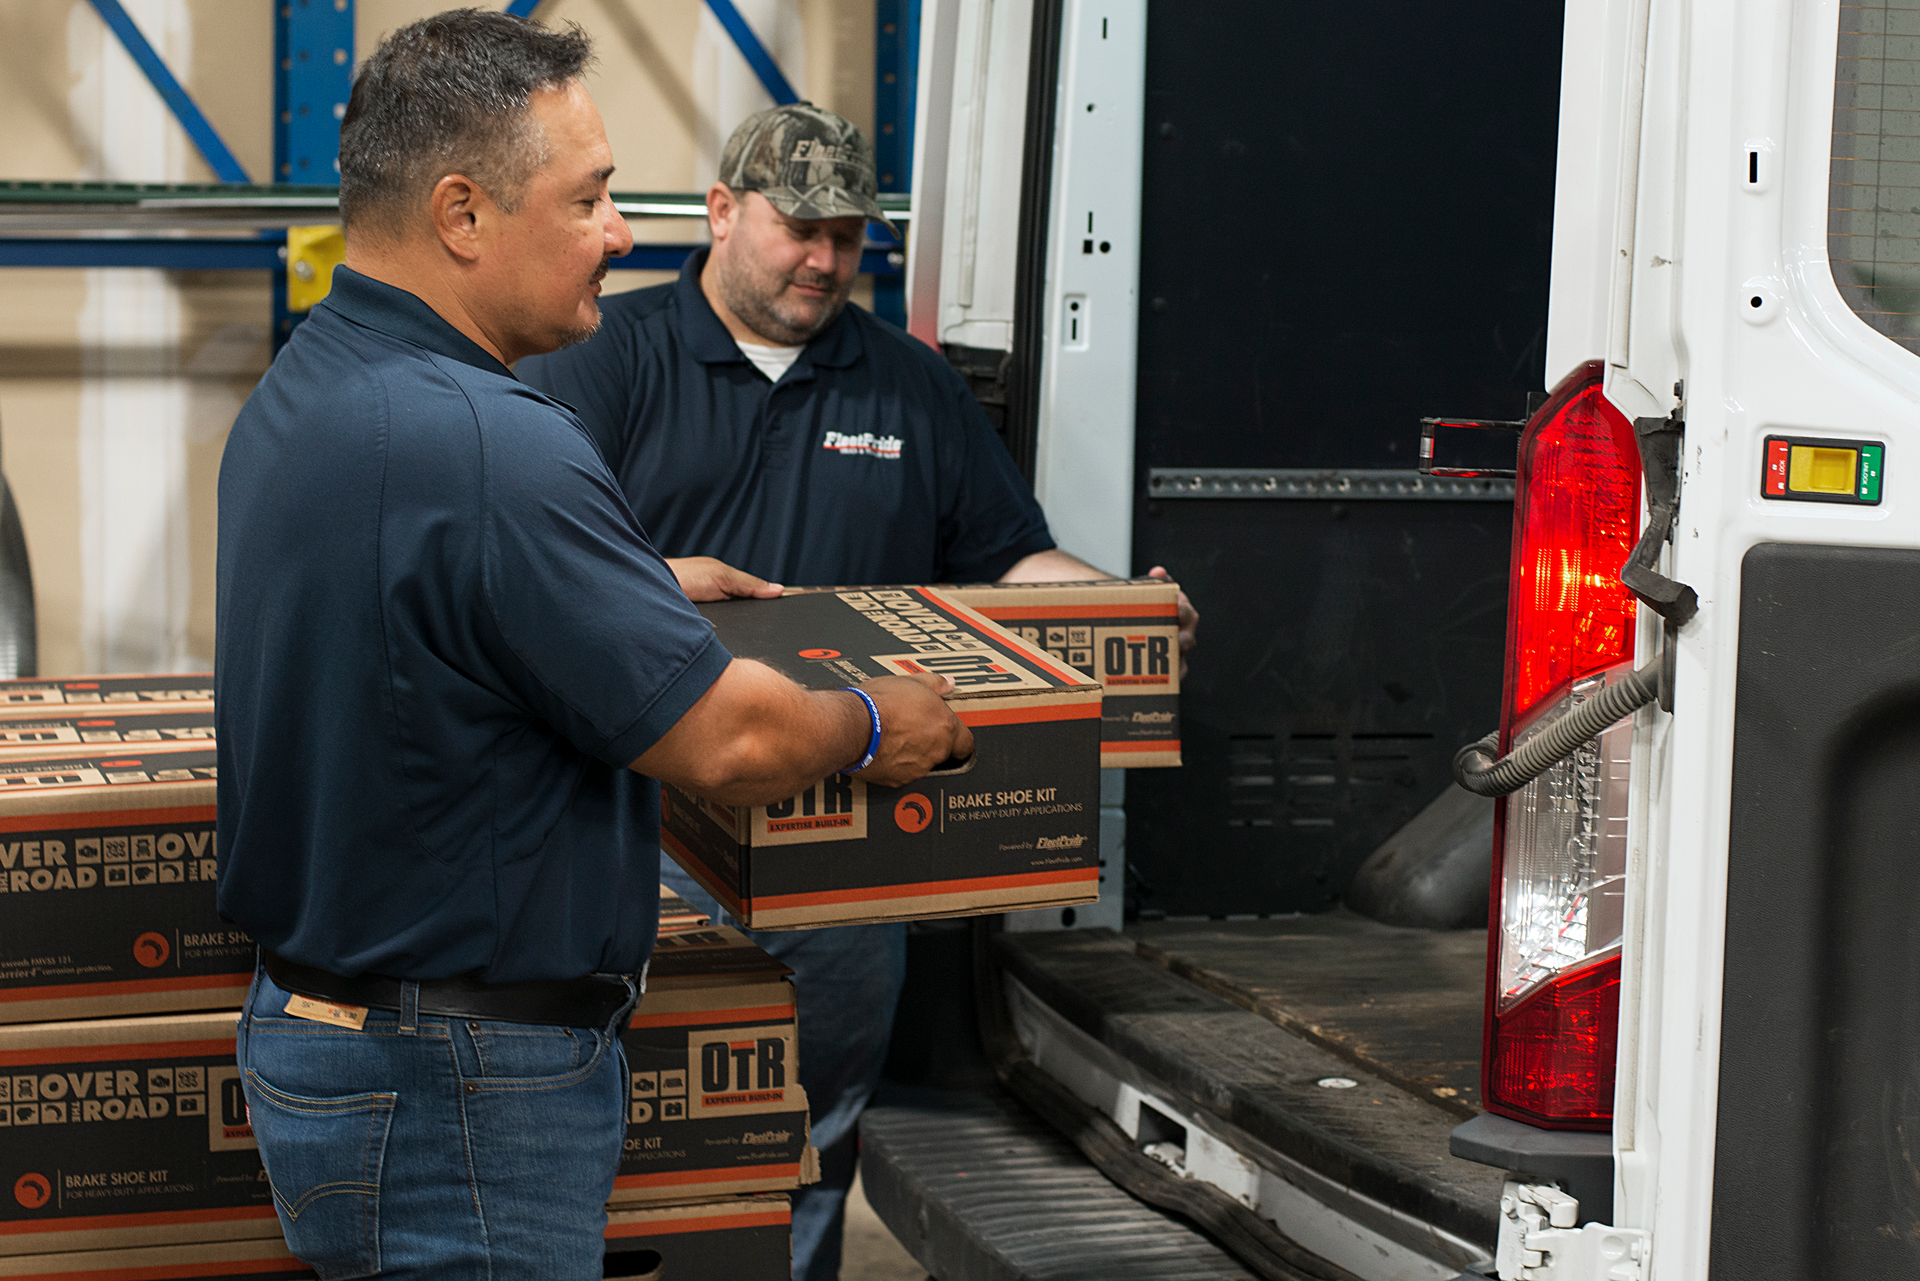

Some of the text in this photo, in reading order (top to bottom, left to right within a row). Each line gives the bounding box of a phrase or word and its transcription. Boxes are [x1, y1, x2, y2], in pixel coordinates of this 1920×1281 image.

[823, 431, 902, 451] FleetPride
[867, 613, 931, 643] ROAD
[884, 600, 958, 633] OVER
[1104, 635, 1170, 676] OTR
[948, 787, 1058, 809] BRAKE SHOE KIT
[949, 803, 1083, 822] FOR HEAVY-DUTY APPLICATIONS
[769, 818, 850, 832] EXPERTISE BUILT-IN
[157, 831, 217, 860] OV
[10, 865, 98, 893] ROAD
[184, 932, 224, 948] BRAKE
[702, 1037, 785, 1093] OTR
[39, 1070, 140, 1100] OVER
[71, 1096, 169, 1123] THE ROAD
[705, 1095, 747, 1105] EXPERTISE
[644, 1136, 662, 1150] KIT
[65, 1169, 168, 1188] BRAKE SHOE KIT
